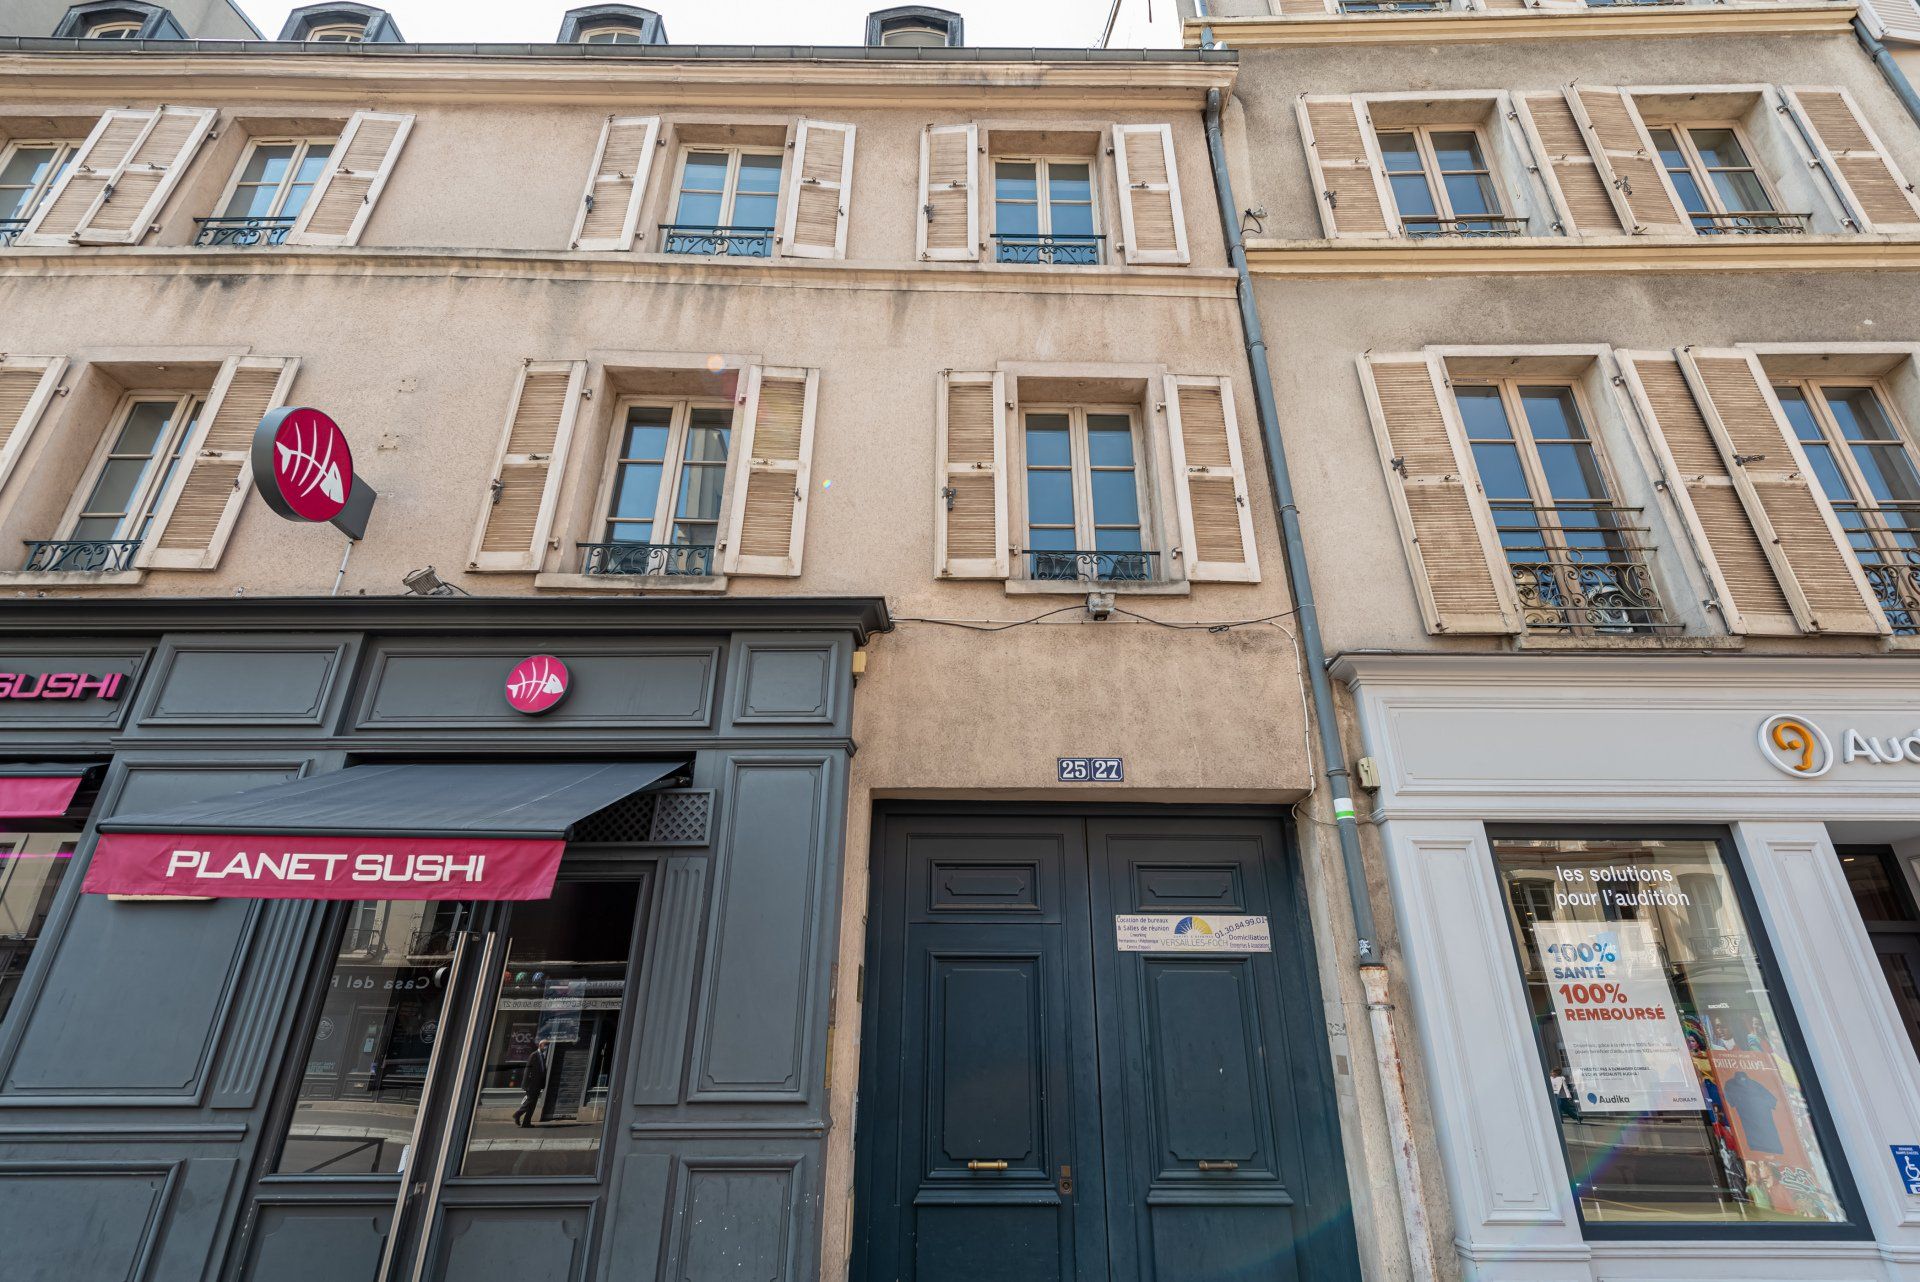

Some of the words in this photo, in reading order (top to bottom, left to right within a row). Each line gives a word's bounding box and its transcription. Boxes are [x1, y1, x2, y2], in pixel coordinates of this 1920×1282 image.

[1062, 760, 1087, 778] 25
[1094, 760, 1119, 778] 27
[165, 850, 348, 881] PLANET
[351, 854, 486, 882] SUSHI
[1556, 865, 1584, 882] les
[1589, 865, 1673, 882] solutions
[1556, 892, 1600, 910] pour
[1602, 889, 1690, 906] l'audition
[1160, 939, 1228, 947] VERSAILLES-FOCH
[1547, 943, 1616, 962] 100%
[1553, 963, 1606, 979] SANTÉ
[1559, 983, 1628, 1004] 100%
[1564, 1004, 1666, 1021] REMBOURSÉ
[1599, 1094, 1631, 1104] Audika
